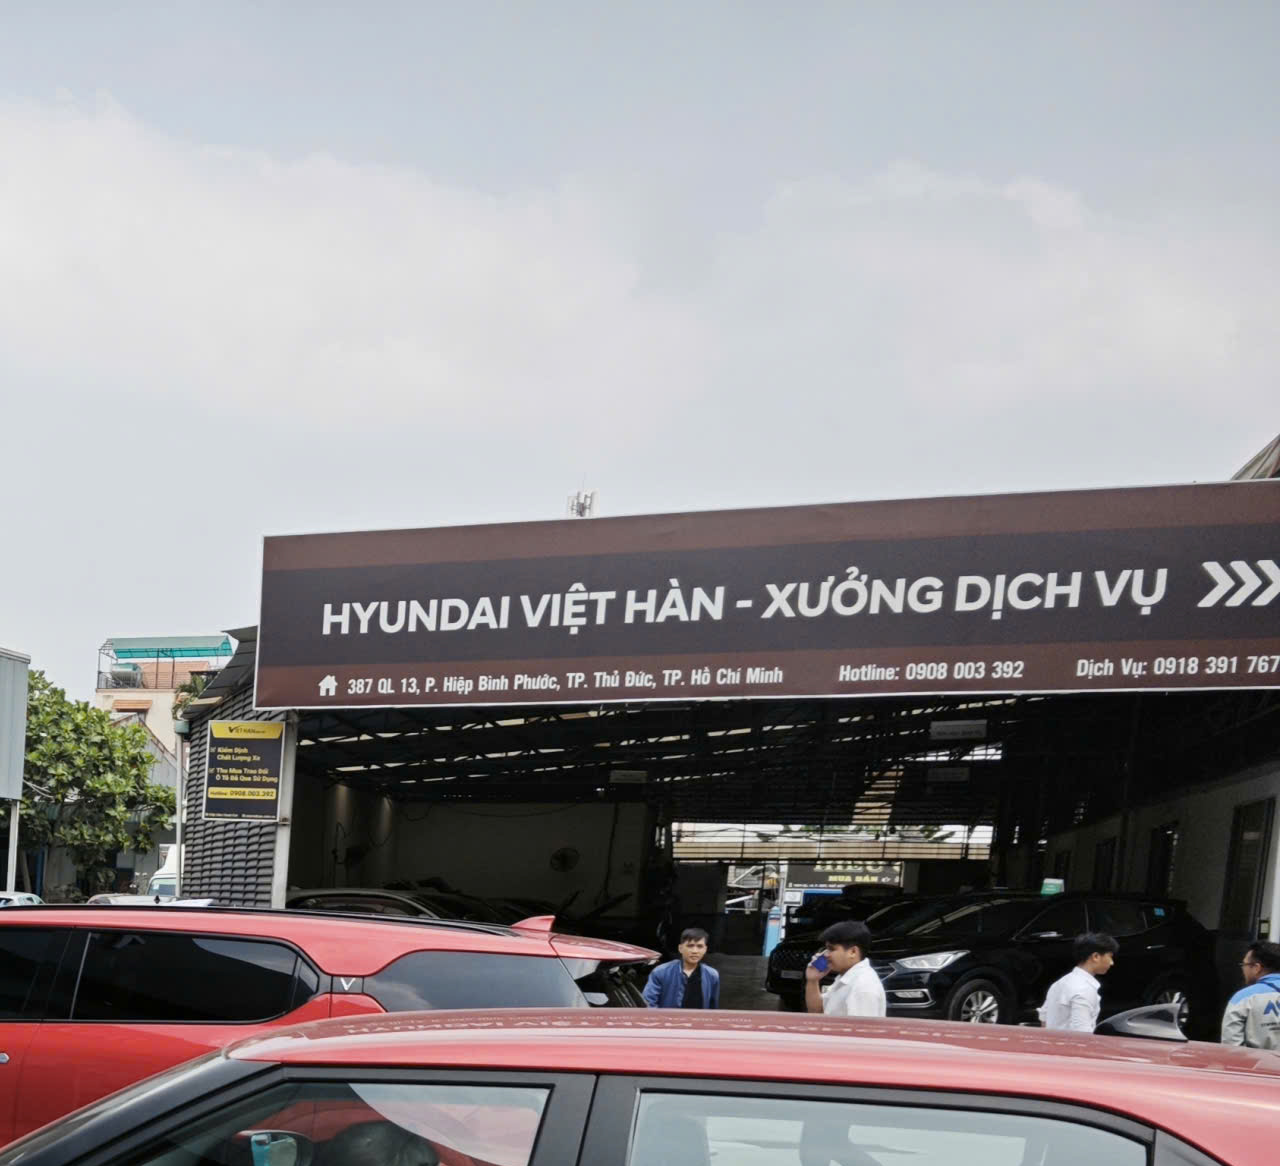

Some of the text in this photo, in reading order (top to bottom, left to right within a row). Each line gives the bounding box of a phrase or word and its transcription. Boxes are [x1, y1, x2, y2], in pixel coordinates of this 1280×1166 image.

[322, 596, 510, 635] HYUNDAI
[520, 582, 616, 635] VIỆT
[624, 578, 724, 624] HÀN
[761, 566, 944, 619] XƯỞNG
[955, 572, 1082, 620] DỊCH
[1095, 568, 1168, 615] VỤ
[839, 661, 1025, 683] Hotline: 0908 003 392
[1076, 655, 1280, 678] Dịch Vụ: 0918 391 767
[347, 665, 783, 696] 387 QL 13, P. Hiệp Bình Phước, TP. Thủ Đức, TP. Hồ Chí Minh
